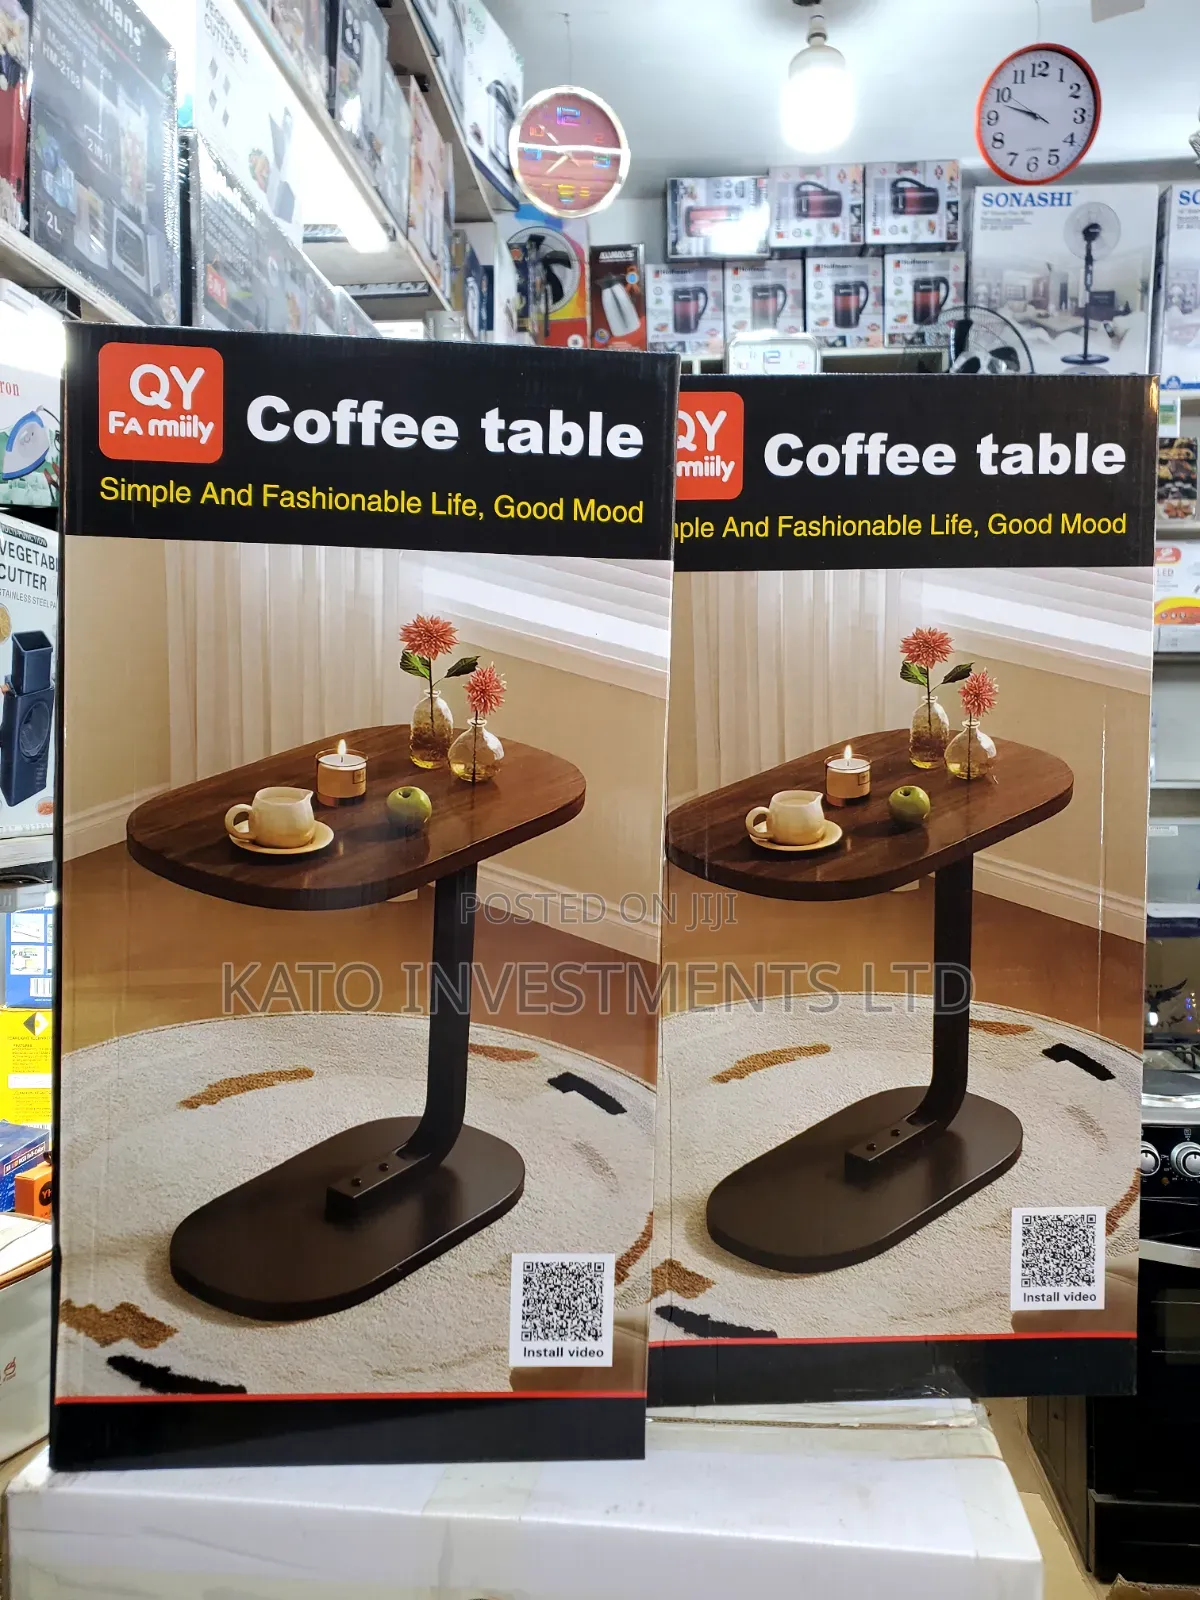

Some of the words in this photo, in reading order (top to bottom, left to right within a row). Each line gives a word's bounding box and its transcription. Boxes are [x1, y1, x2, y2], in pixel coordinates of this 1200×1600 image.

[1012, 70, 1025, 84] 11
[1030, 61, 1050, 78] 12
[1058, 68, 1065, 83] 1
[995, 87, 1012, 103] 10
[1068, 83, 1081, 99] 2
[986, 110, 999, 126] 9
[1073, 107, 1086, 124] 3
[991, 132, 1005, 149] 8
[1062, 132, 1076, 147] 4
[1007, 152, 1019, 167] 7
[1026, 156, 1039, 172] 6
[1047, 149, 1060, 166] 5
[982, 191, 1073, 208] SONASHI
[129, 363, 205, 411] QY
[246, 395, 459, 451] Coffee
[480, 407, 644, 458] table
[764, 432, 957, 477] Coffee
[976, 432, 1127, 476] table
[100, 477, 191, 507] Simple
[200, 482, 253, 506] And
[262, 484, 422, 515] Fashionable
[431, 491, 485, 521] Life,
[494, 494, 564, 521] Good
[573, 498, 644, 524] Mood
[673, 517, 714, 543] ple
[722, 516, 769, 538] And
[778, 514, 923, 538] Fashionable
[930, 513, 979, 539] Life,
[988, 513, 1053, 535] Good
[1061, 512, 1127, 535] Mood
[0, 563, 47, 592] CUTTER
[0, 588, 31, 604] TAINLESS
[1023, 1292, 1060, 1303] Install
[1063, 1291, 1097, 1302] video
[523, 1346, 564, 1358] Install
[568, 1346, 604, 1358] video
